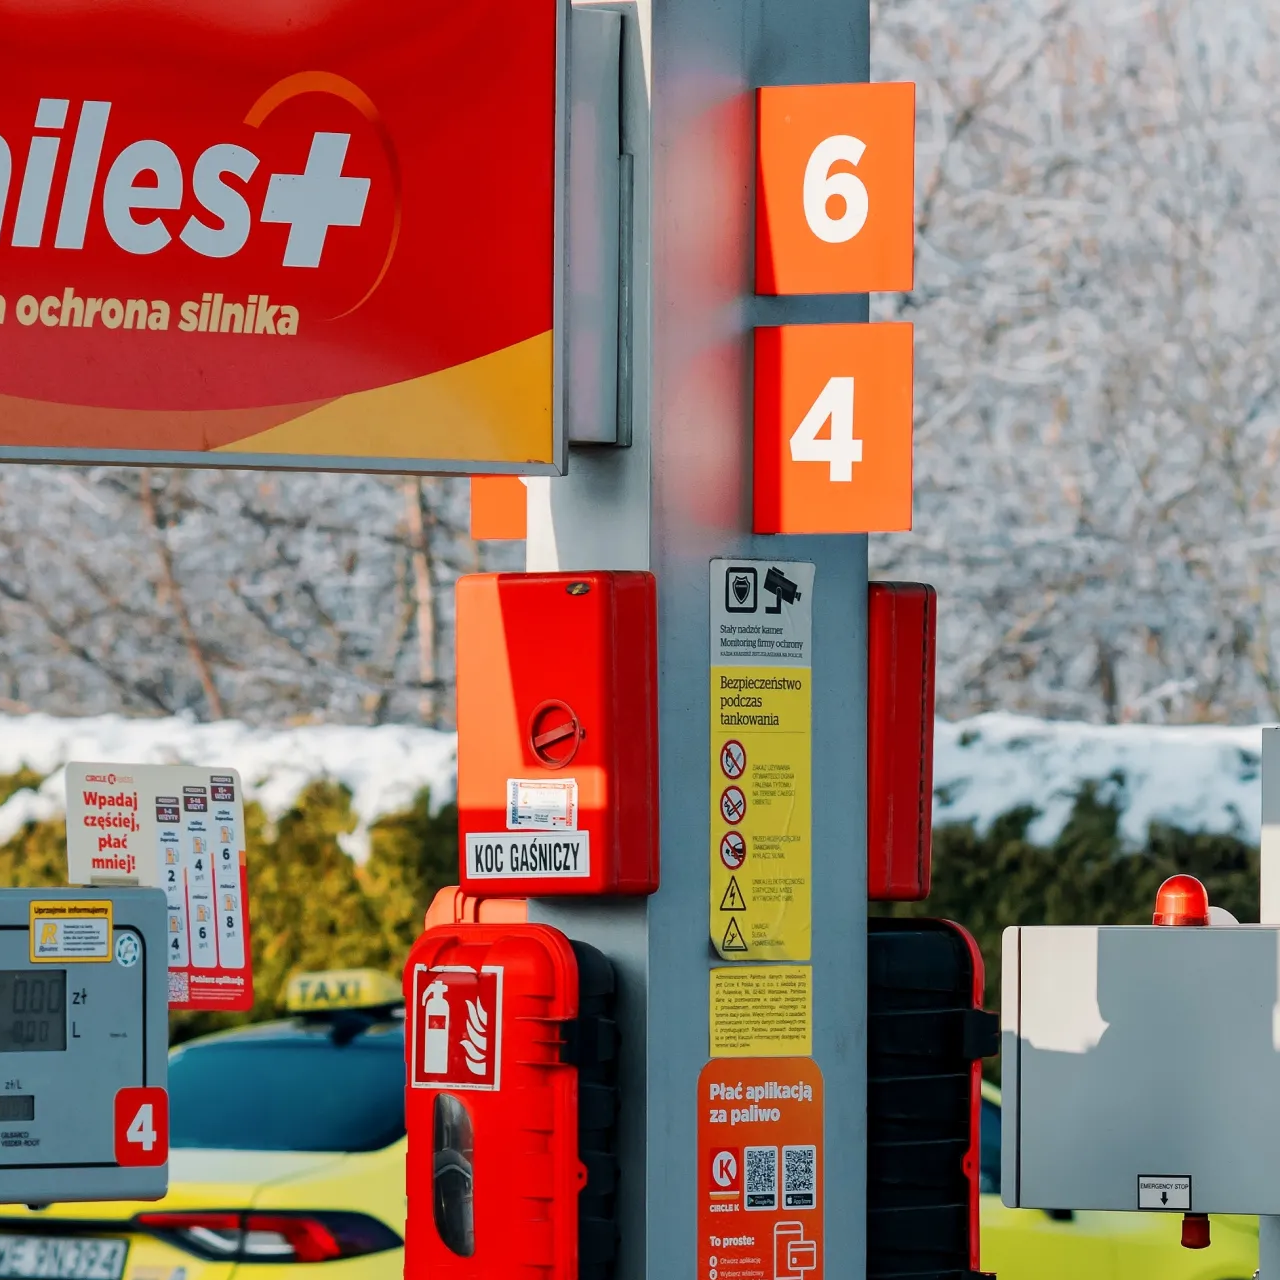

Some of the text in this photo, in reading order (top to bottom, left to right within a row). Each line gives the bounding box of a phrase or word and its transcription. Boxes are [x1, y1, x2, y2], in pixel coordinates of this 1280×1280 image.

[803, 135, 868, 243] 6
[15, 287, 170, 331] ochrona
[178, 291, 299, 336] silnika
[789, 377, 863, 482] 4
[720, 625, 783, 635] Stały nadzór kamer
[720, 638, 803, 650] Monitoring firmy ochrony
[720, 676, 801, 691] Bezpieczeństwo
[720, 694, 762, 709] podczas
[720, 712, 779, 725] tankowania
[83, 791, 138, 811] Wpadaj
[84, 812, 140, 832] częściej,
[98, 833, 127, 851] płać
[92, 855, 136, 873] mniej!
[475, 838, 580, 873] KOC GAŚNICZY
[68, 906, 108, 914] informujemy
[72, 988, 87, 1004] zł
[72, 1022, 80, 1038] L
[710, 1081, 812, 1102] Płać aplikacją
[710, 1105, 780, 1126] za paliwo
[127, 1104, 157, 1151] 4
[710, 1235, 755, 1248] To proste:
